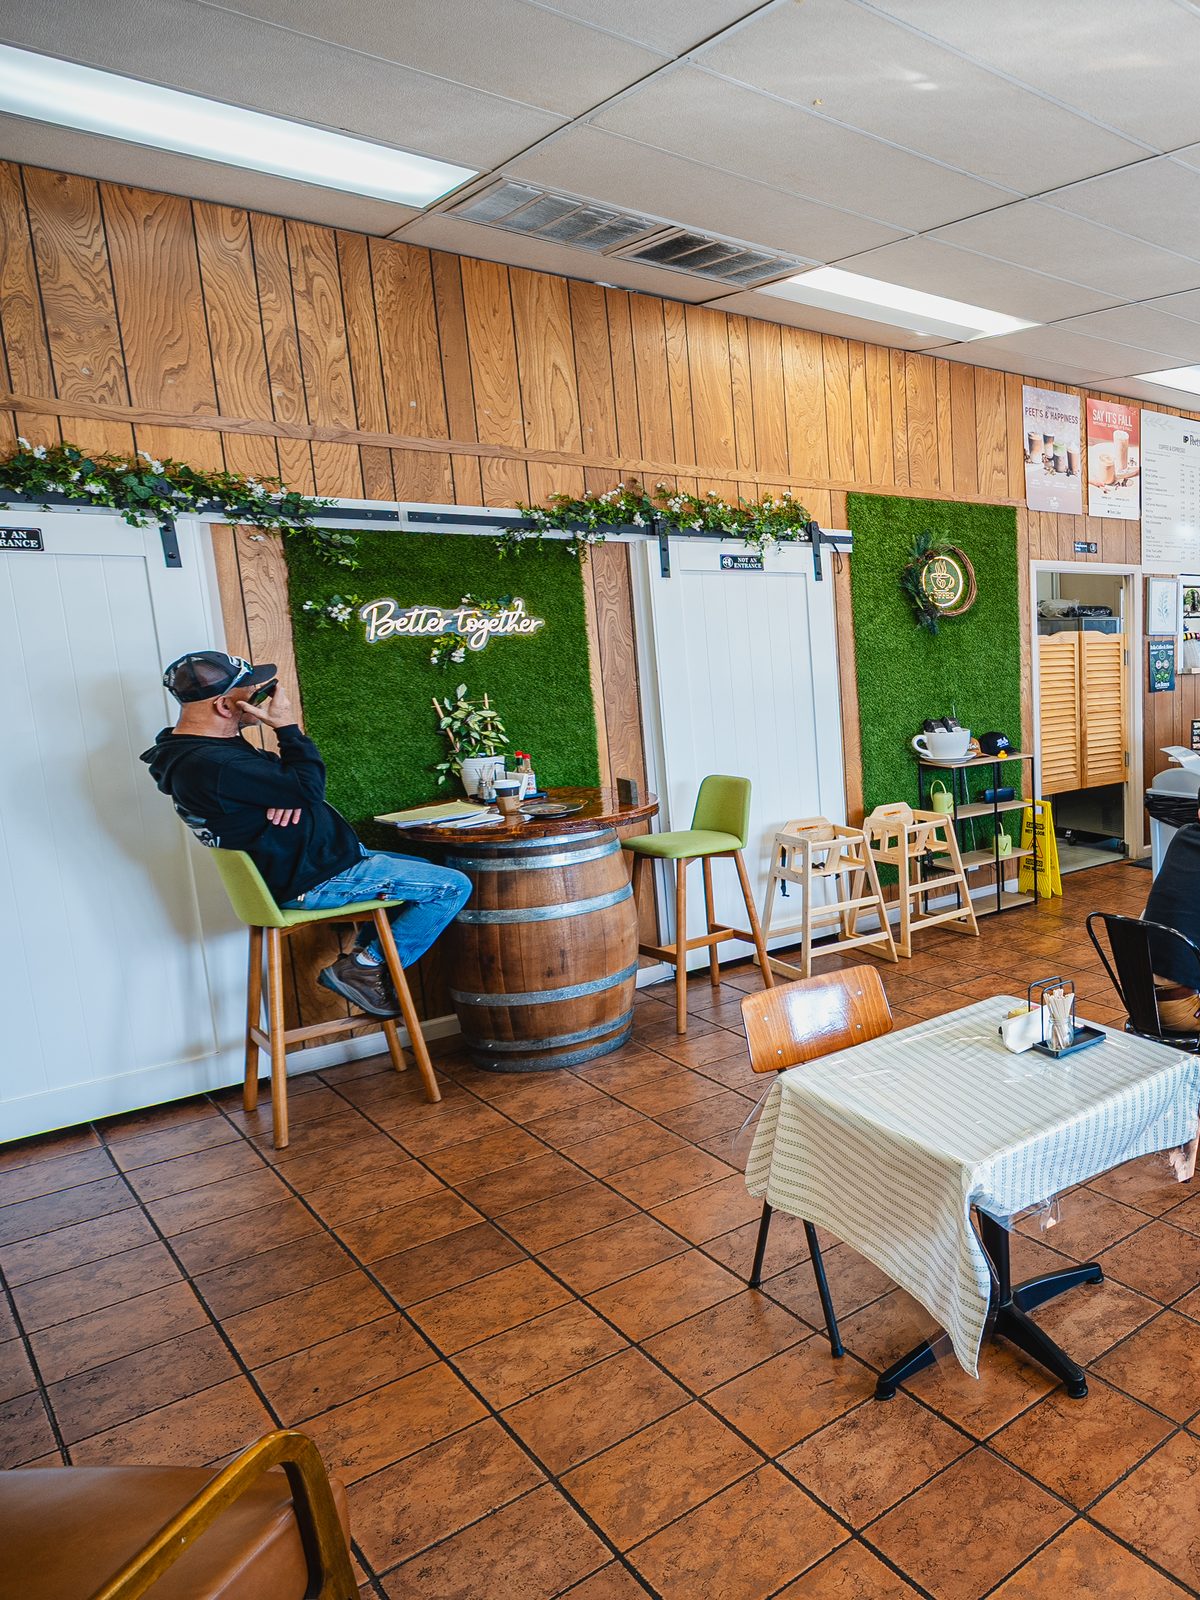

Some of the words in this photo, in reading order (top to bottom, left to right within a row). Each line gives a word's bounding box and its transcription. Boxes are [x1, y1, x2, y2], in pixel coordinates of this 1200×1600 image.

[1024, 406, 1044, 418] PEET'S
[1044, 411, 1049, 419] &
[1050, 411, 1079, 424] HAPPINESS
[1092, 409, 1105, 422] SAY
[1105, 411, 1117, 424] IT'S
[1117, 413, 1133, 427] FALL
[11, 531, 27, 539] AN
[362, 601, 452, 641] Better
[453, 598, 543, 649] together
